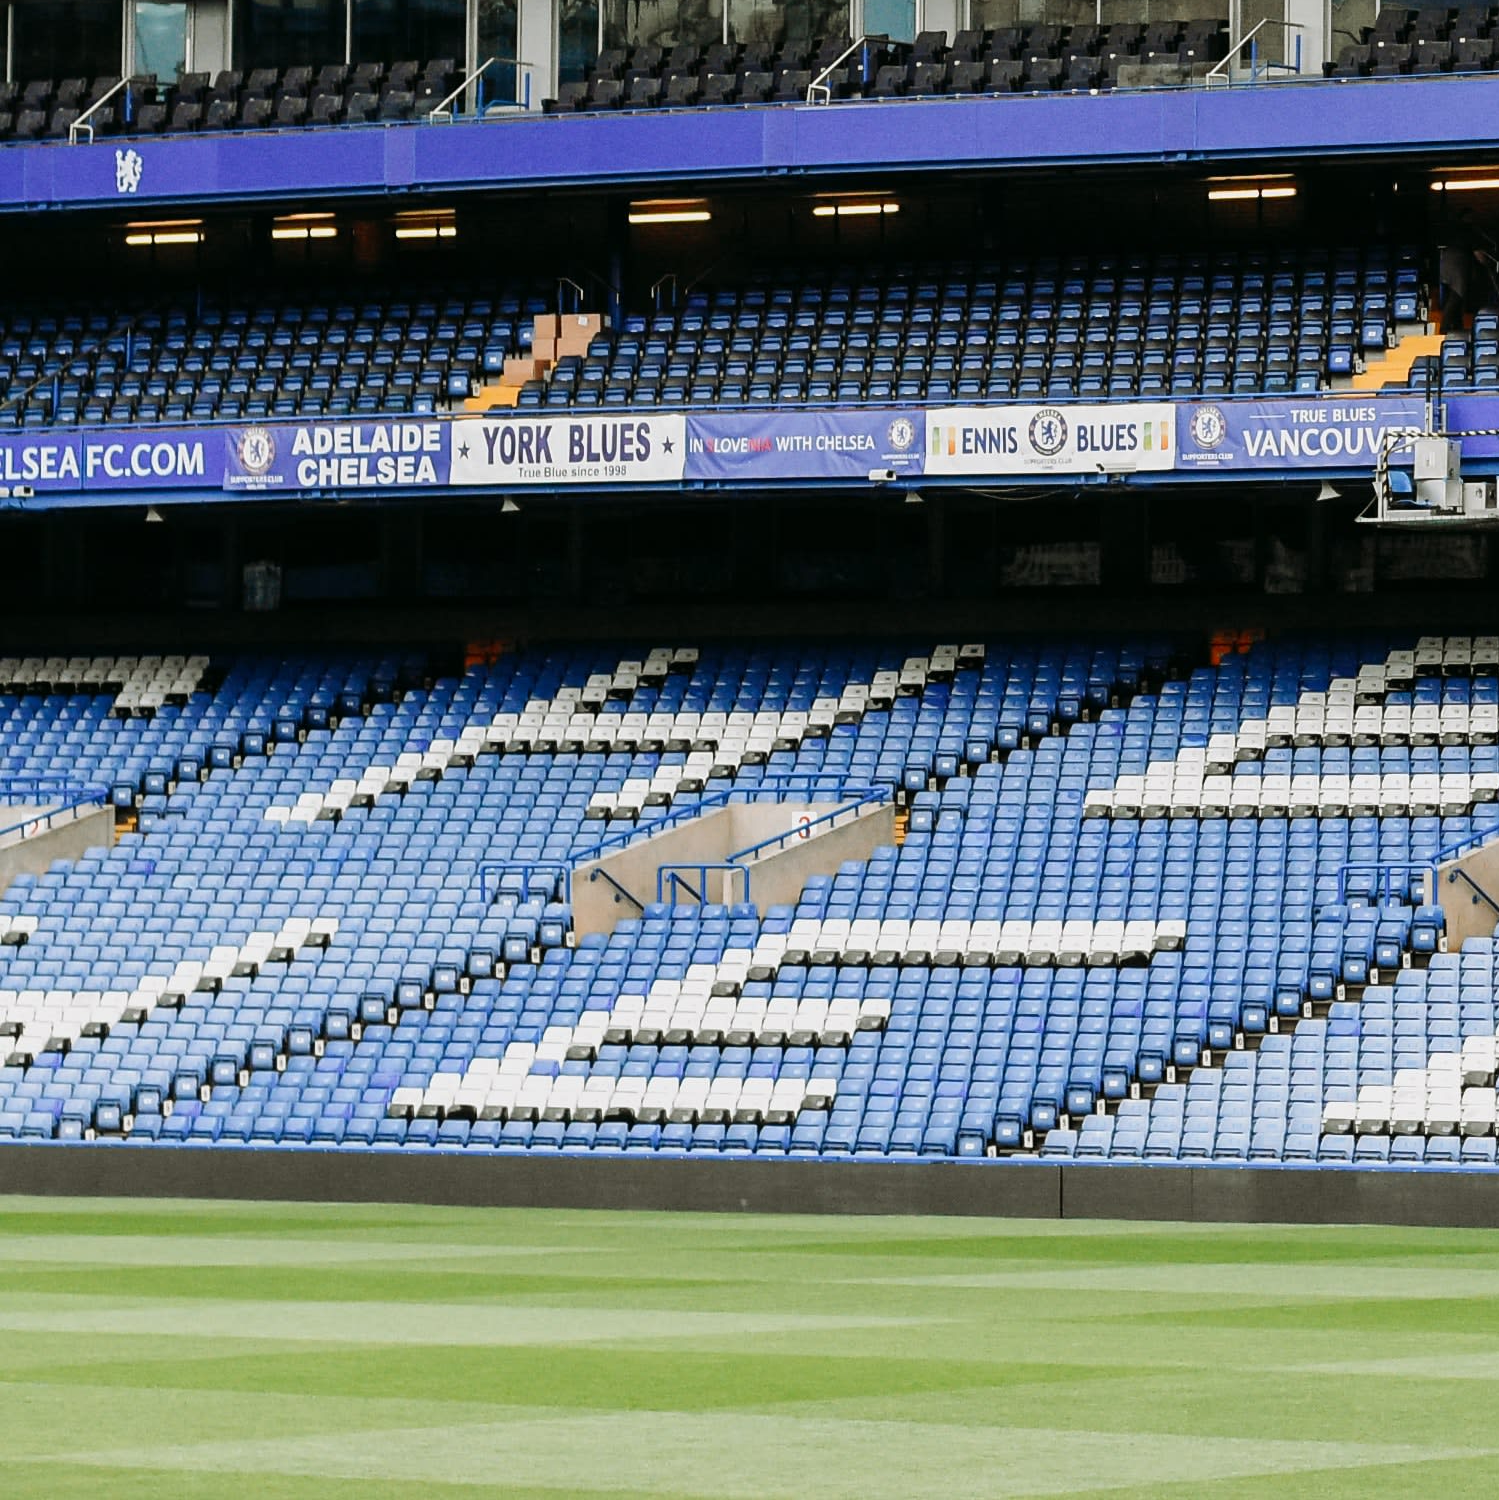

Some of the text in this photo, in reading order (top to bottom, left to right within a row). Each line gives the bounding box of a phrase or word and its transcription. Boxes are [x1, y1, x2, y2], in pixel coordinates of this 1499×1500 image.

[1290, 407, 1376, 423] TRUE BLUES
[291, 423, 441, 456] ADELAIDE
[482, 422, 651, 466] YORK BLUES
[689, 434, 876, 454] IN SLOVENIA WITH CHELSEA
[962, 423, 1138, 454] ENNIS BLUES
[0, 442, 205, 480] LSEAFC.COM
[297, 456, 438, 487] CHELSEA
[518, 465, 627, 479] True Blue since 1998
[798, 815, 811, 840] 3
